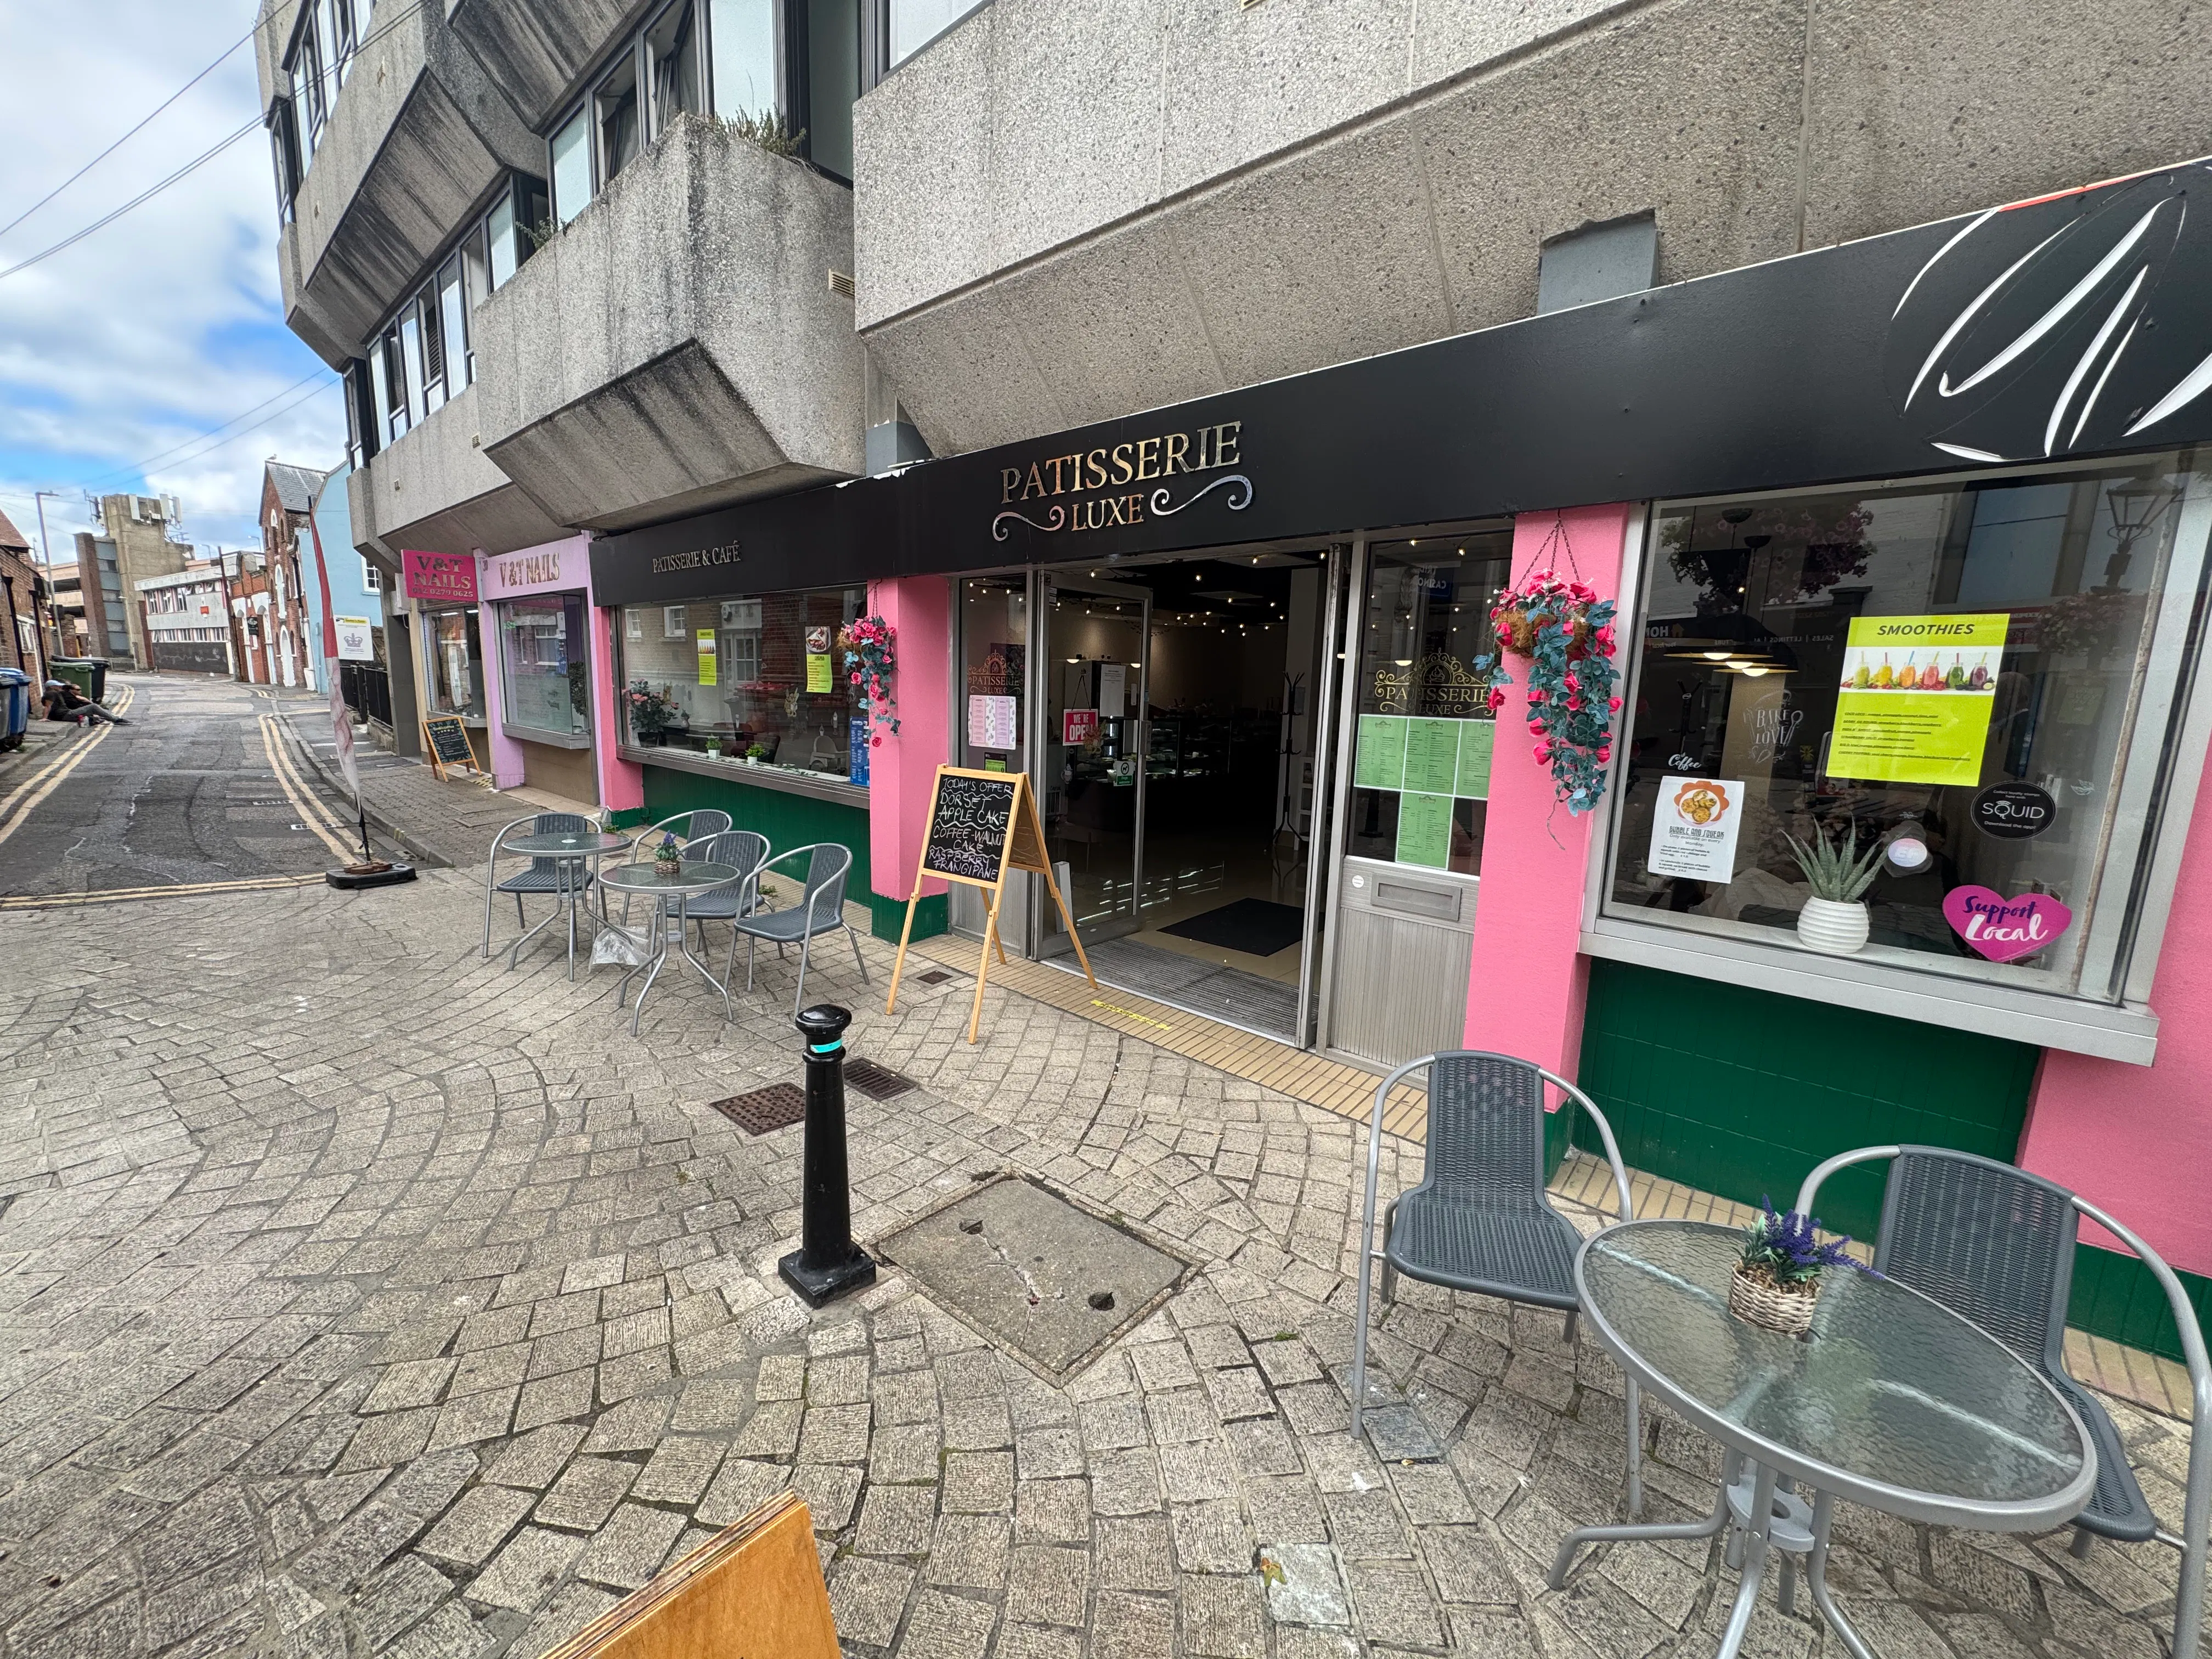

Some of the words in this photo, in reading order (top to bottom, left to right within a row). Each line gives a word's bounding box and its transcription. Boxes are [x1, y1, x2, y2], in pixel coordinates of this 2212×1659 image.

[1000, 420, 1243, 504] PATISSERIE
[1071, 494, 1144, 531] LUXE
[416, 556, 464, 573] V&T
[653, 551, 702, 573] PATISSERIE
[702, 550, 711, 566] &
[712, 540, 741, 564] CAFÉ
[526, 552, 560, 585] NAILS
[414, 572, 472, 590] NAILS
[1877, 624, 1975, 635] SMOOTHIES
[972, 676, 1020, 686] PATISSERIE
[1386, 687, 1488, 702] PAISSERIE
[1073, 713, 1089, 724] WE'RE
[1420, 704, 1451, 714] LUXE
[1756, 709, 1790, 728] BAKE
[1756, 726, 1787, 745] LOVE
[1668, 752, 1702, 770] Coffee
[943, 776, 976, 791] TODAY'S
[979, 782, 1013, 795] OFFER
[940, 792, 992, 811] DORSET
[1982, 801, 2045, 820] SQUID
[938, 805, 974, 822] APPLE
[977, 809, 1009, 826] CAKE
[1669, 826, 1690, 834] BUBBLE
[1691, 828, 1702, 836] AND
[1702, 830, 1725, 838] SQUEAK
[953, 839, 984, 854] CAKE
[929, 849, 989, 869] RASPBERRY
[933, 859, 998, 880] FRANGIPANE
[1963, 896, 2037, 924] Support
[1965, 913, 2049, 941] Local
